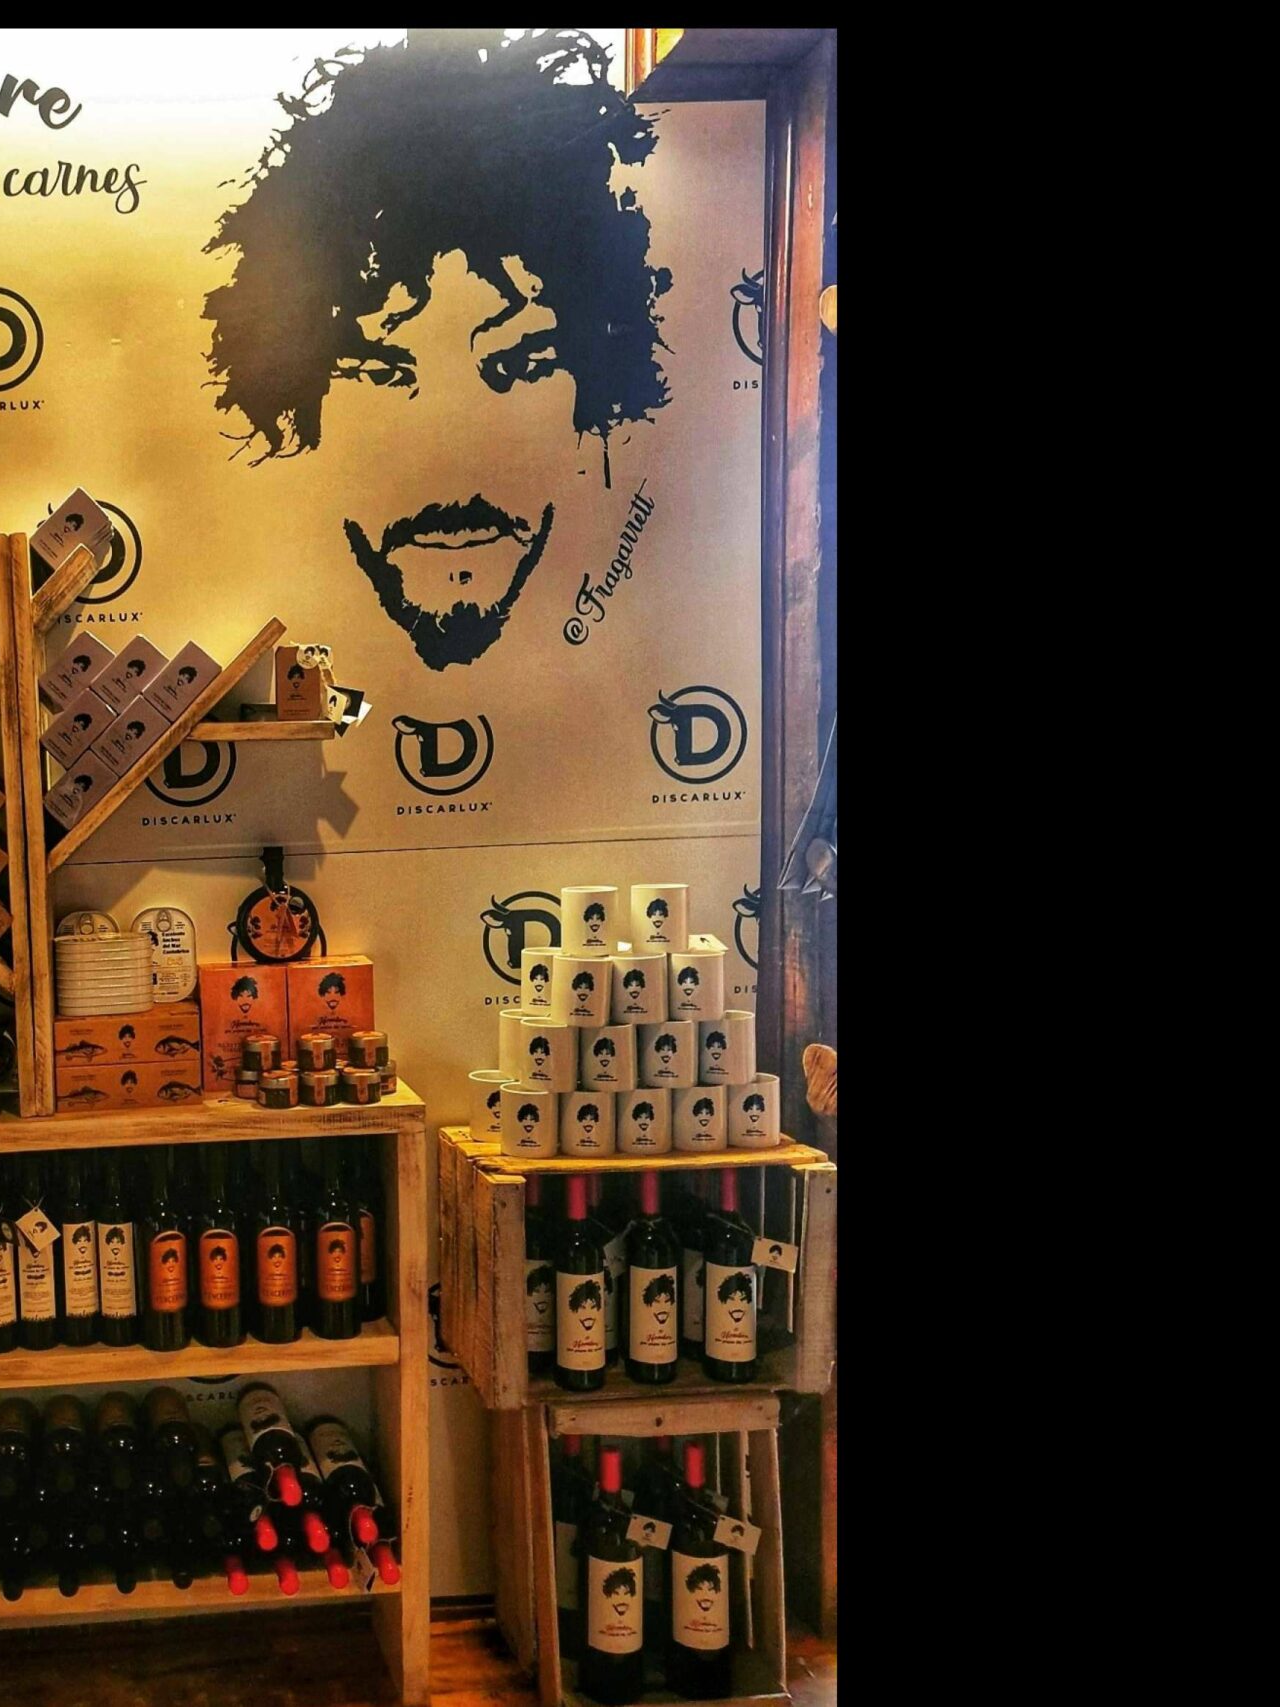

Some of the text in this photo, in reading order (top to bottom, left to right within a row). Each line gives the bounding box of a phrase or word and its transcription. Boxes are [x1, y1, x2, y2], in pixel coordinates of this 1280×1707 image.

[3, 160, 148, 214] carnes
[563, 478, 655, 646] @Fragarrett
[57, 612, 143, 624] ISCARLUX
[652, 791, 746, 804] DISCARLUX
[397, 802, 493, 815] DISCARLUX
[142, 814, 236, 826] DISCARLUX
